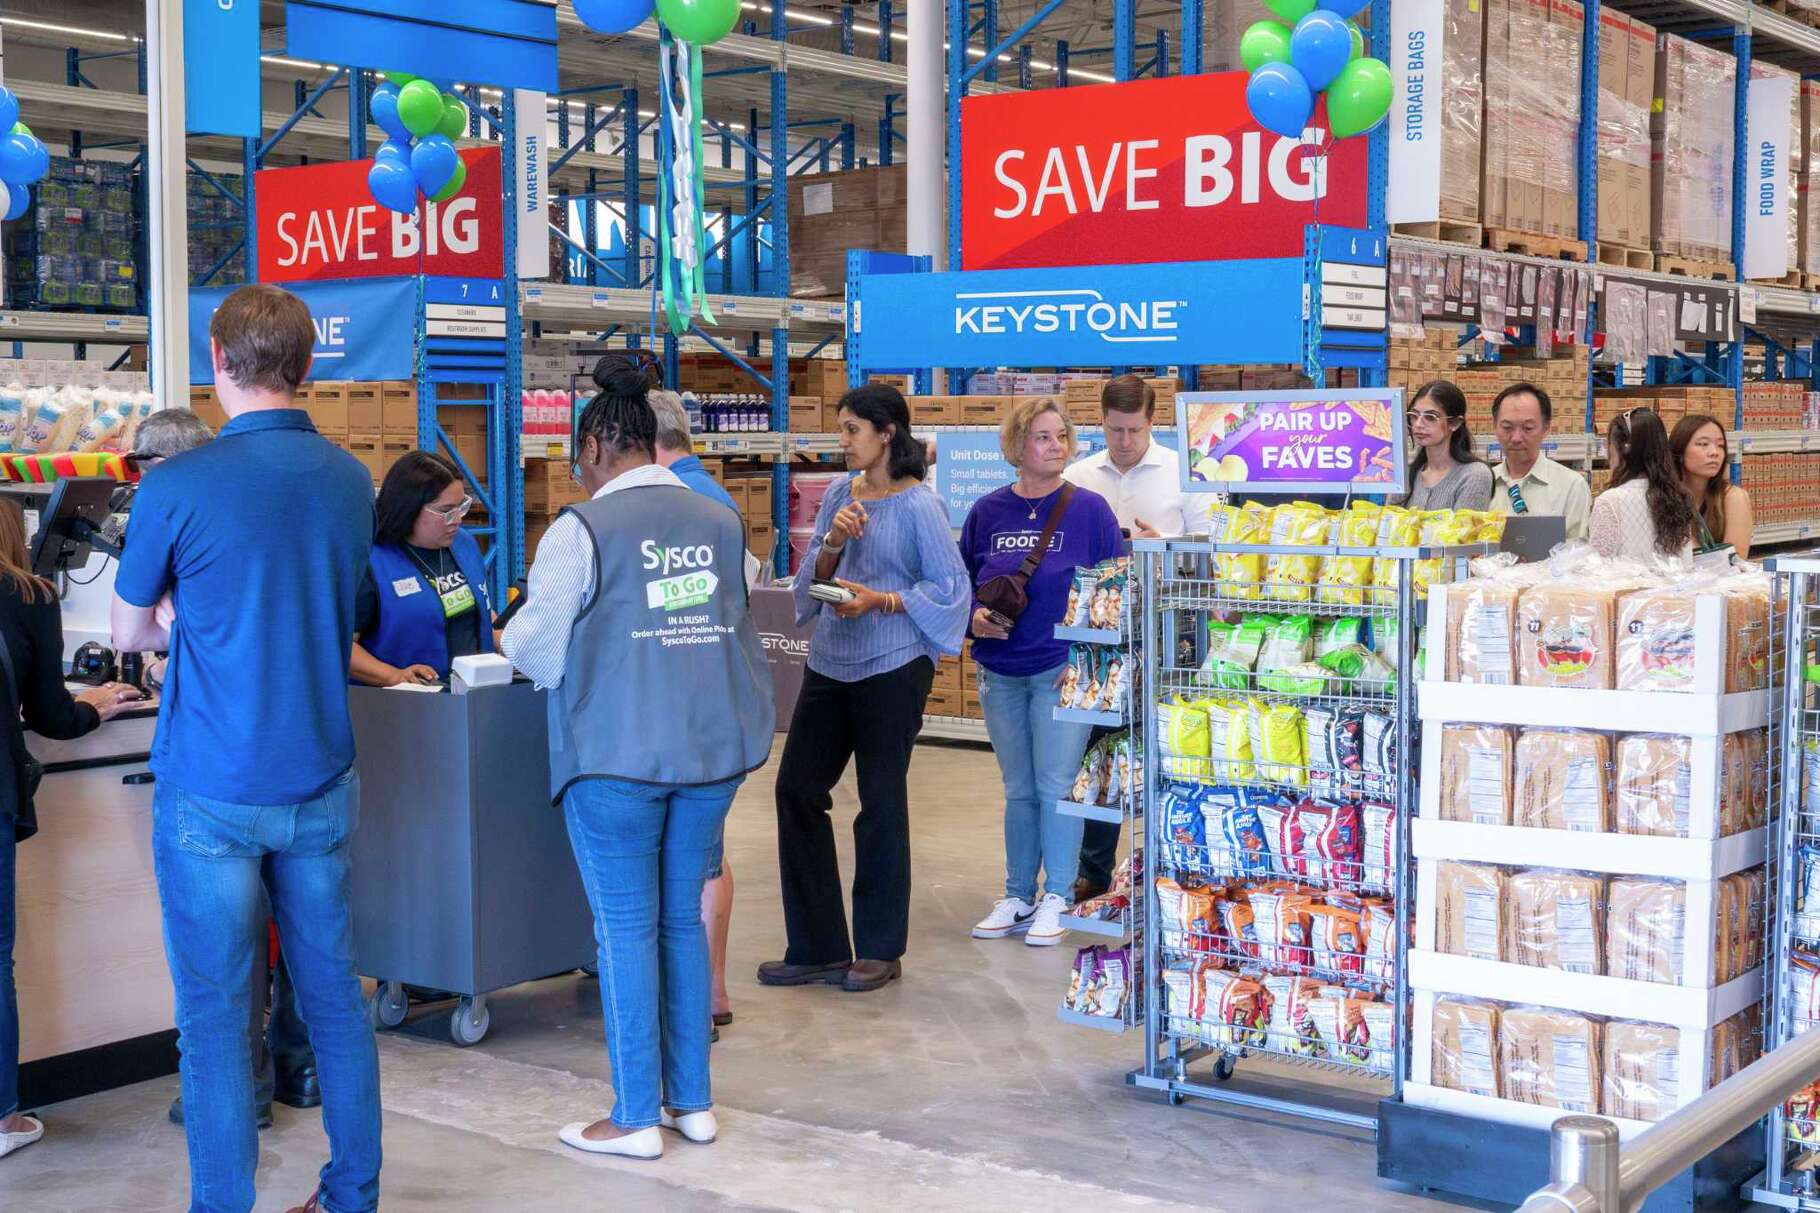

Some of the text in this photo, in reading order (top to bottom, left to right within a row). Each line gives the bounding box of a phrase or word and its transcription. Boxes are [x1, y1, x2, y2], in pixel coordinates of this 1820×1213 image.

[1406, 31, 1425, 141] STORAGE BAGS
[526, 135, 538, 213] WAREWASH
[992, 127, 1328, 219] SAVE BIG
[1760, 141, 1776, 216] FOOD WRAP
[276, 197, 479, 267] SAVE BIG
[1351, 237, 1357, 255] 6
[1374, 240, 1380, 257] A
[462, 284, 468, 298] 7
[491, 285, 498, 299] A
[955, 300, 1178, 335] KEYSTONE
[1260, 412, 1352, 431] PAIR UP
[1288, 434, 1328, 457] your
[950, 449, 971, 461] Unit
[974, 450, 1000, 461] Dose
[1262, 446, 1353, 469] FAVES
[951, 468, 1008, 479] Small tablets.
[951, 483, 965, 496] Big
[950, 498, 962, 508] for
[996, 536, 1056, 549] FOODE
[641, 540, 714, 575] Sysco
[659, 577, 707, 598] To Go
[668, 615, 709, 625] IN A RUSH?
[631, 628, 654, 639] Order
[655, 627, 677, 637] ahead
[678, 626, 690, 635] with
[691, 625, 713, 635] Online
[662, 635, 720, 647] SyscoToGo.com
[760, 637, 809, 652] STONE
